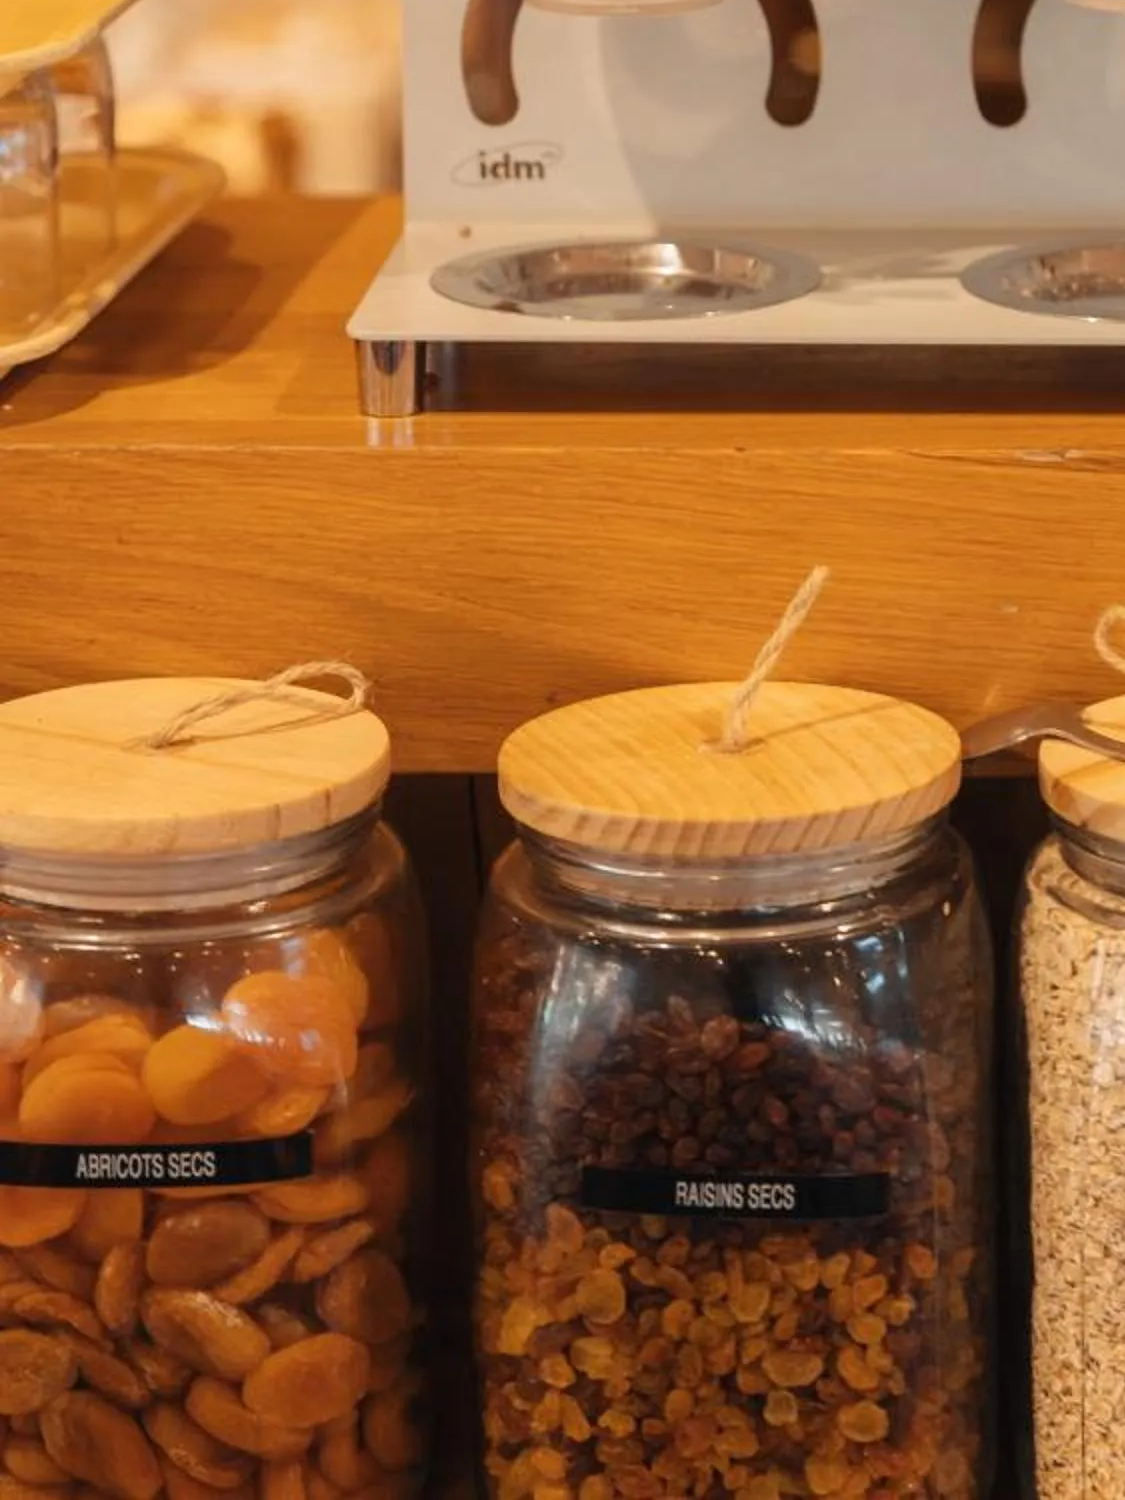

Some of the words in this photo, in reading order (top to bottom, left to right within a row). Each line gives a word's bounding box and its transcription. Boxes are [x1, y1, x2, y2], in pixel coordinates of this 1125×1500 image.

[479, 151, 545, 180] idm
[76, 1152, 164, 1179] ABRICOTS
[167, 1151, 216, 1177] SECS
[675, 1181, 744, 1209] RAISINS
[747, 1184, 796, 1210] SECS
